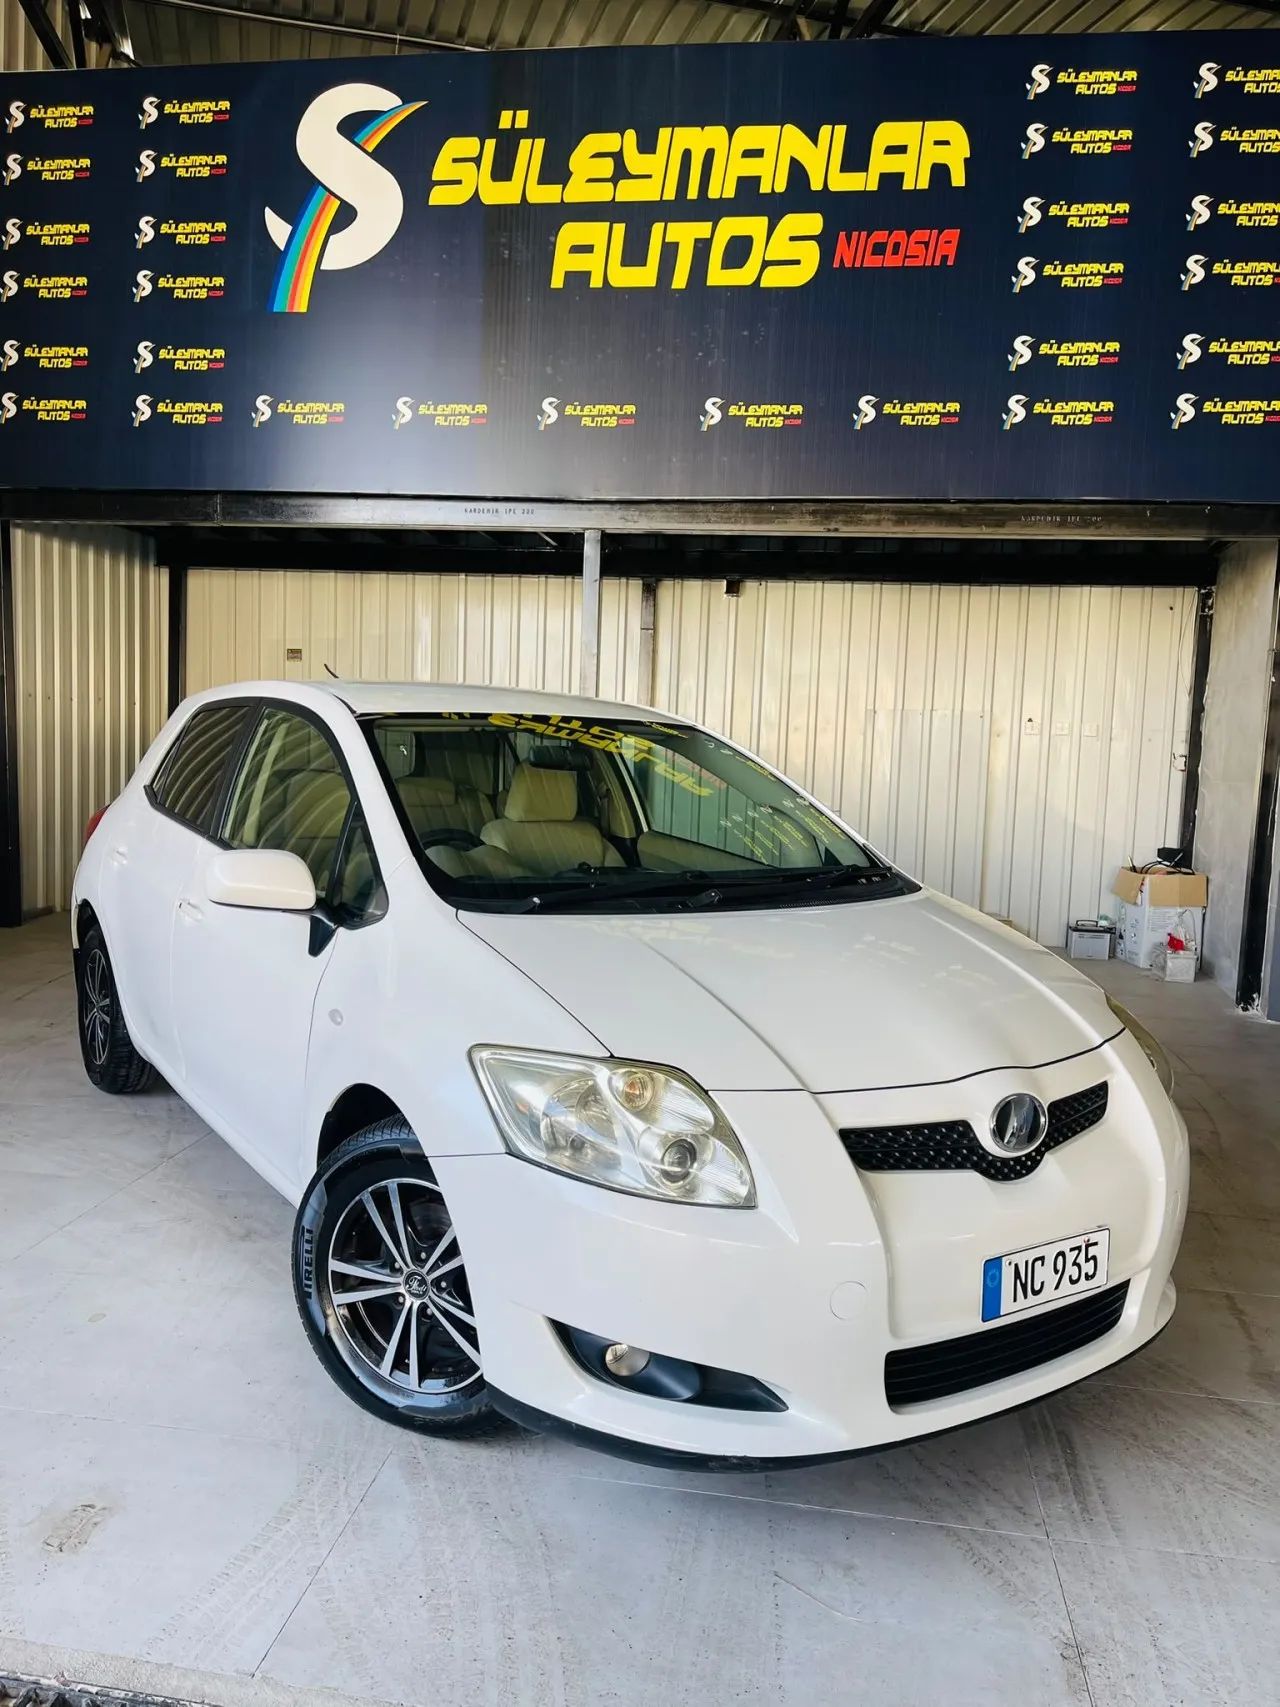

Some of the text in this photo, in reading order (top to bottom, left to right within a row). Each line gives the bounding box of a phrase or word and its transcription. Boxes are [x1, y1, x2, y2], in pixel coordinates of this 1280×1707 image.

[1075, 83, 1117, 94] AUTOS
[44, 117, 77, 128] AUTOS
[179, 113, 213, 123] AUTOS
[1070, 142, 1112, 153] AUTOS
[429, 110, 970, 205] SÜLEYMANLAR
[41, 170, 74, 180] AUTOS
[176, 167, 210, 177] AUTOS
[1067, 216, 1108, 227] AUTOS
[1235, 215, 1278, 226] AUTOS
[40, 235, 73, 245] AUTOS
[175, 234, 209, 244] AUTOS
[550, 213, 960, 289] AUTOS NICOSIA
[1061, 275, 1103, 287] AUTOS
[1230, 275, 1273, 286] AUTOS
[38, 288, 71, 298] AUTOS
[174, 288, 207, 298] AUTOS
[39, 358, 72, 368] AUTOS
[1057, 354, 1098, 366] AUTOS
[1226, 353, 1270, 364] AUTOS
[174, 360, 208, 370] AUTOS
[1202, 398, 1280, 412] SÜLEYMANLA
[37, 411, 70, 420] AUTOS
[172, 414, 206, 424] AUTOS
[293, 414, 327, 424] AUTOS
[434, 415, 469, 425] AUTOS
[900, 414, 940, 425] AUTOS
[1051, 414, 1093, 425] AUTOS
[1220, 413, 1264, 424] AUTOS
[580, 416, 617, 427] AUTOS
[745, 417, 784, 428] AUTOS
[1013, 1241, 1099, 1303] NC 935
